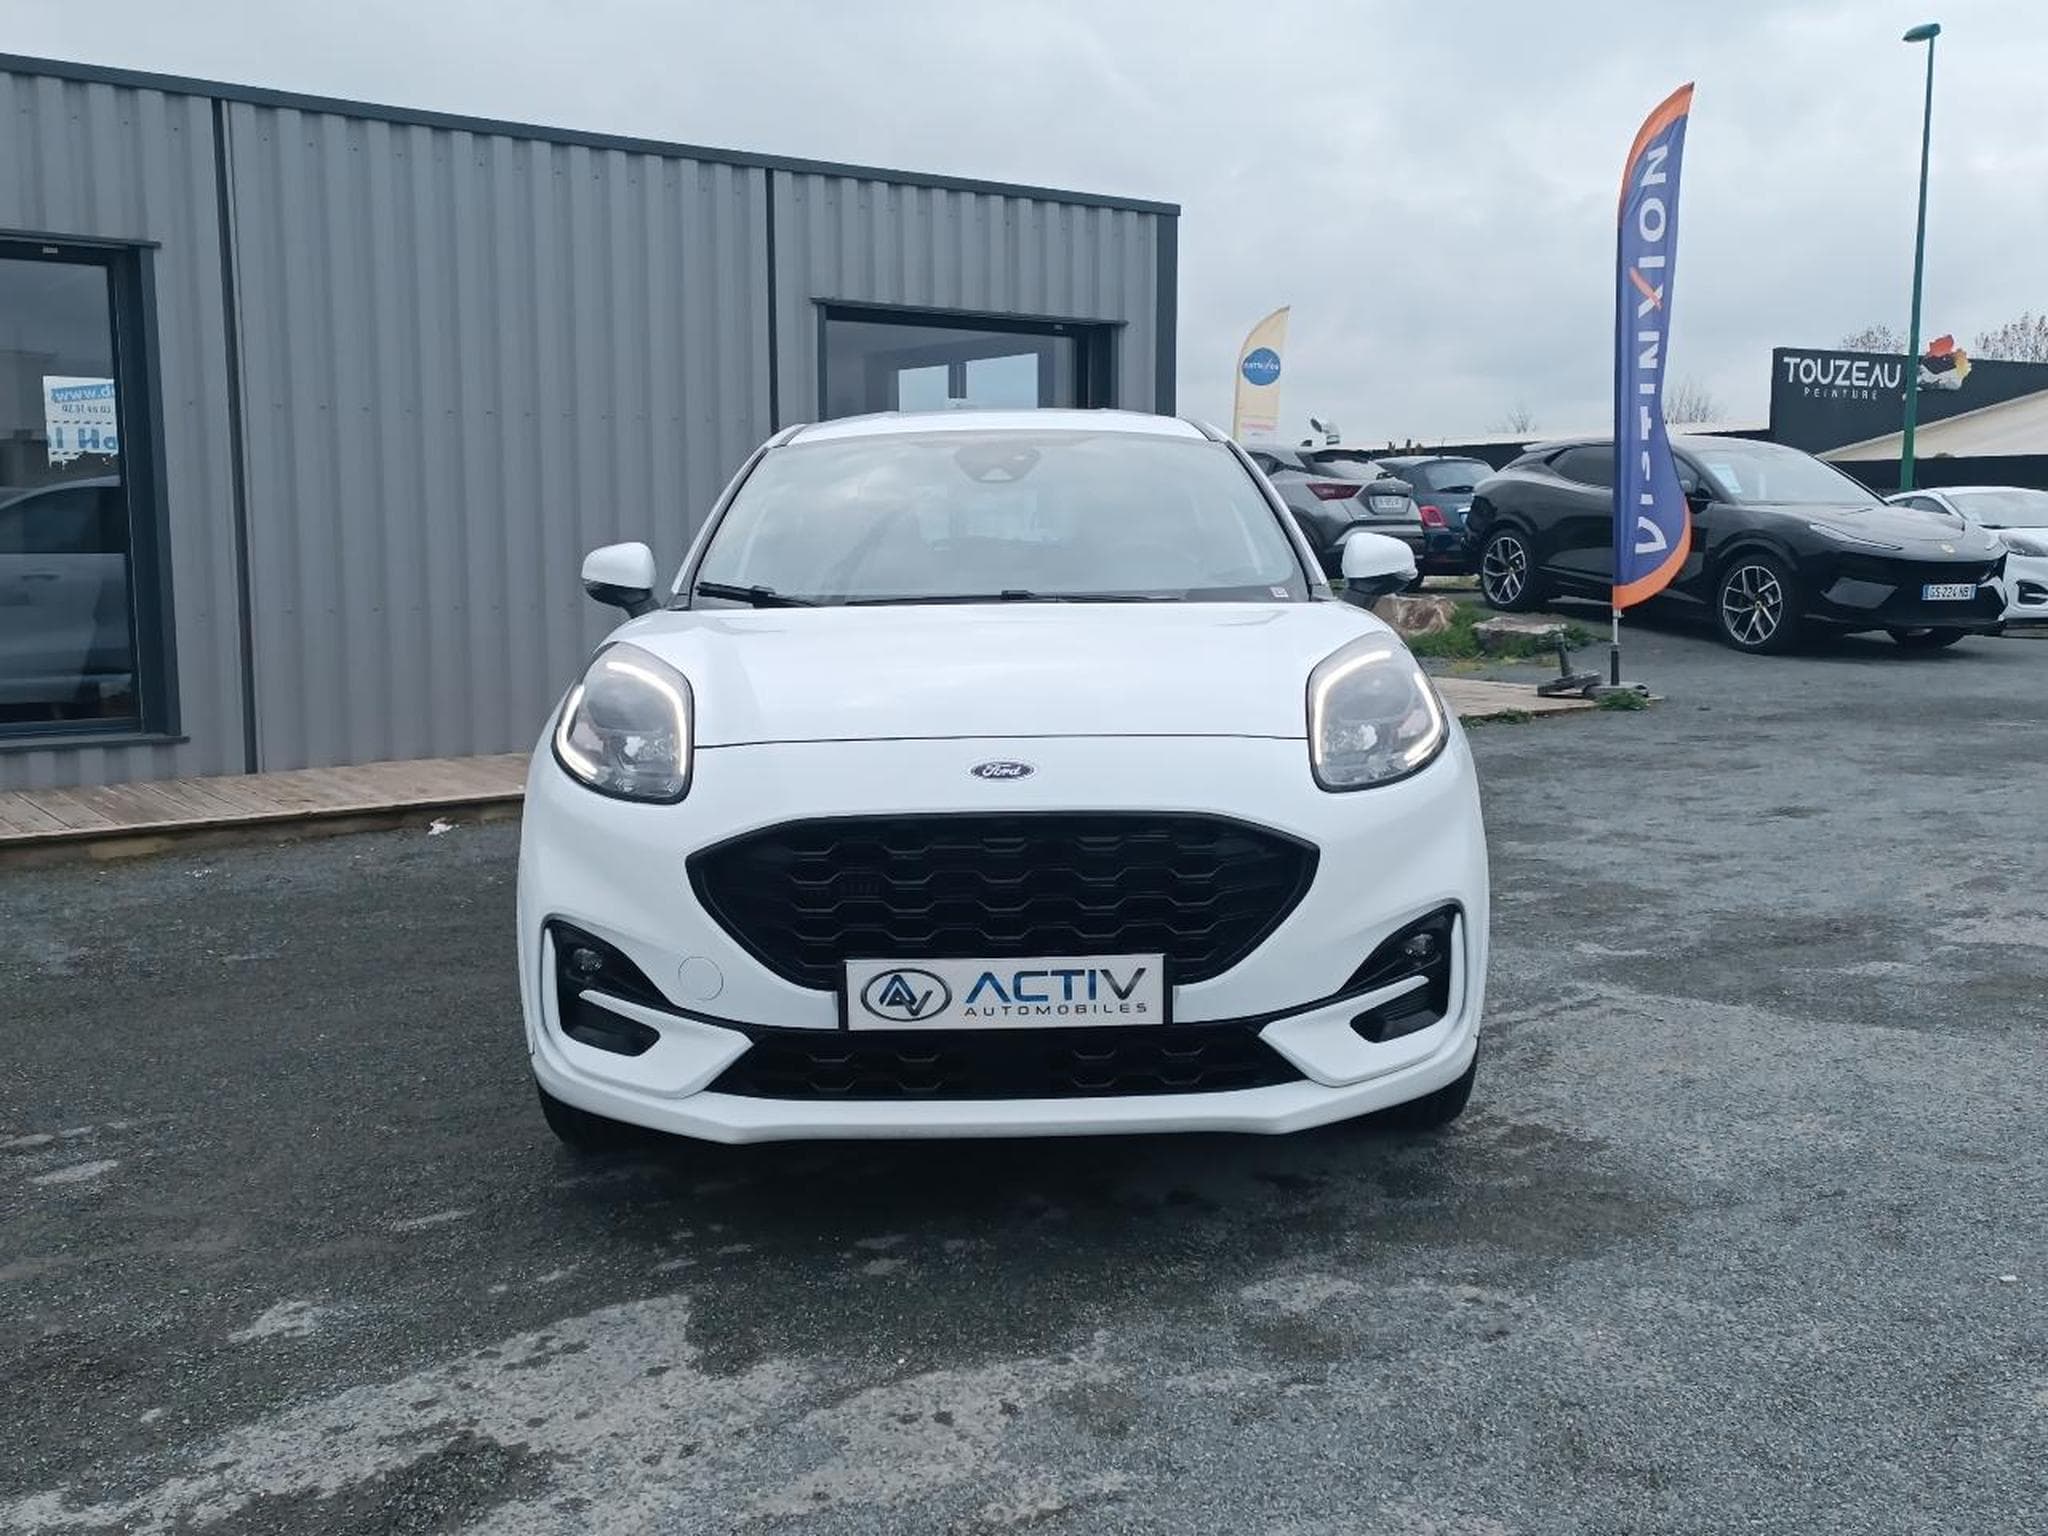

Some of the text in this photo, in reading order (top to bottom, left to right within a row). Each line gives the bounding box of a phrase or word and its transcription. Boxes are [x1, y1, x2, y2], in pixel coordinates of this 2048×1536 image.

[1783, 356, 1902, 388] TOUZEAU
[1804, 387, 1878, 400] PEINTURE
[982, 763, 1022, 777] Ford
[965, 967, 1147, 1004] ACTIV
[964, 1002, 1148, 1017] AUTOMOBILES
